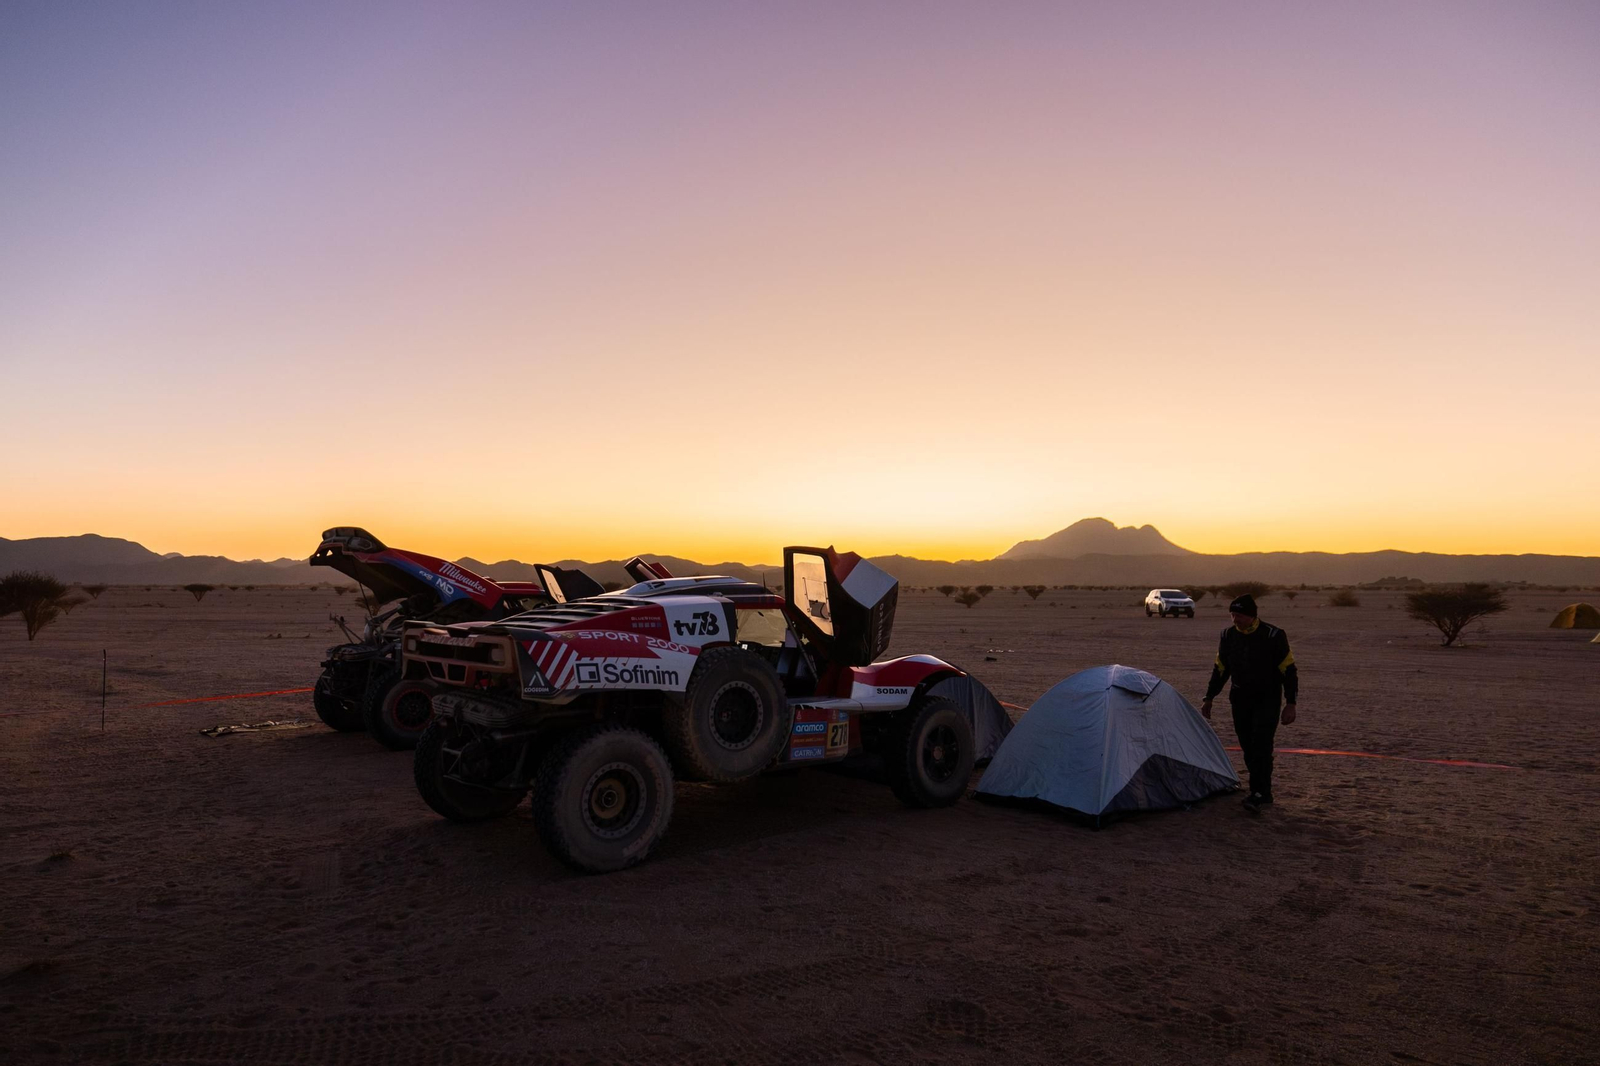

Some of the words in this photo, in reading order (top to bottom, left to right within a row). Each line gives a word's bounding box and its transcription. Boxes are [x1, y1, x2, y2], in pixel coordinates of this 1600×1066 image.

[435, 578, 455, 595] MD
[438, 561, 487, 594] Milwaukee
[578, 631, 640, 643] SPORT
[646, 636, 690, 654] 2000
[603, 663, 679, 685] Sofinim
[795, 724, 825, 732] aramco
